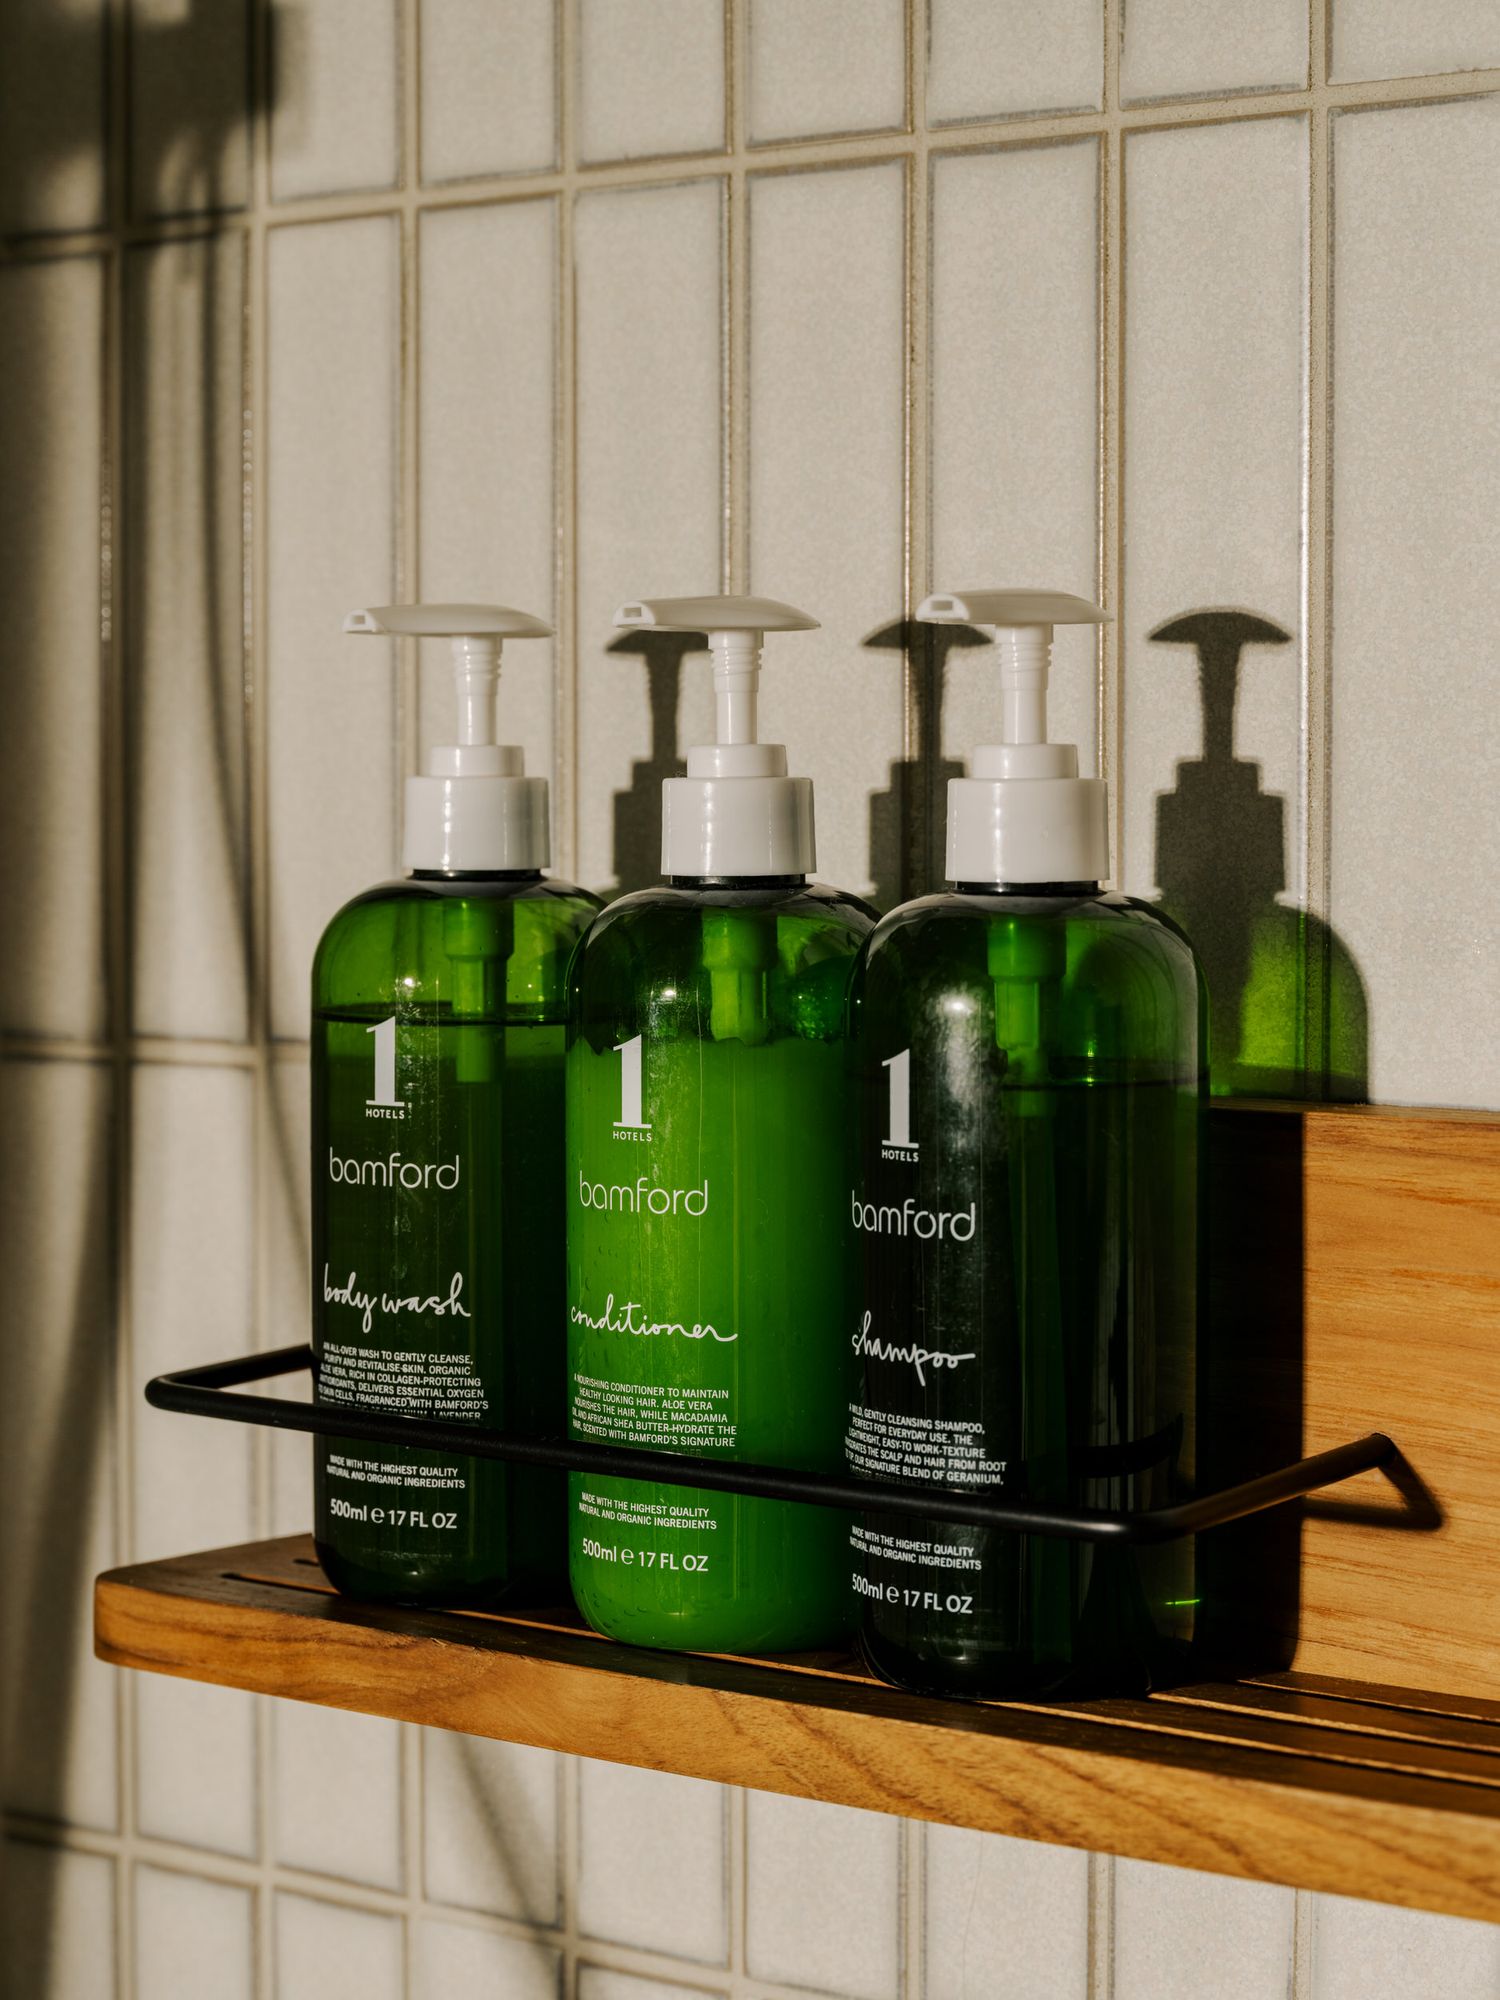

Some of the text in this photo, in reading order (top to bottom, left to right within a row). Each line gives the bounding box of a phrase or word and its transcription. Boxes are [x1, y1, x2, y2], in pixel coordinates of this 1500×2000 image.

[366, 1015, 405, 1107] 1
[613, 1034, 652, 1129] 1
[881, 1048, 919, 1149] 1
[365, 1108, 405, 1119] HOTELS
[612, 1131, 652, 1142] HOTELS
[329, 1146, 460, 1190] bamford
[881, 1149, 919, 1162] HOTELS
[579, 1170, 708, 1216] bamford
[852, 1190, 976, 1242] bamford
[323, 1262, 471, 1334] body wash
[571, 1293, 738, 1342] conditioner
[358, 1348, 379, 1359] WASH
[381, 1351, 392, 1360] TO
[394, 1352, 430, 1363] GENTLY
[428, 1354, 474, 1365] CLEANSE,
[851, 1310, 976, 1387] shampoo
[343, 1357, 356, 1366] AND
[429, 1366, 471, 1375] ORGANIC
[349, 1369, 365, 1380] RICH
[367, 1371, 375, 1381] IN
[377, 1373, 481, 1387] COLLAGEN-PROTECTING
[335, 1390, 355, 1401] CELLS,
[356, 1393, 407, 1407] FRAGRANCED
[409, 1397, 432, 1408] WITH
[435, 1400, 489, 1409] BAMFORD'S
[358, 1382, 394, 1395] DELIVERS
[397, 1386, 444, 1397] ESSENTIAL
[447, 1389, 484, 1398] OXYGEN
[577, 1375, 609, 1390] NOURISHING
[610, 1382, 664, 1396] CONDITIONER
[667, 1387, 680, 1397] TO
[682, 1389, 729, 1399] MAINTAIN
[579, 1387, 713, 1410] HEALTHY LOOKING HAIR. ALOE VERA
[588, 1412, 612, 1425] AFRICAN
[614, 1418, 633, 1429] SHEA
[636, 1422, 714, 1435] BUTTER-HYDRATE
[717, 1426, 737, 1435] THE
[602, 1404, 615, 1415] THE
[617, 1407, 638, 1419] HAIR,
[640, 1410, 668, 1420] WHILE
[671, 1412, 728, 1423] MACADAMIA
[864, 1409, 886, 1422] GENTLY
[887, 1414, 933, 1429] CLEANSING
[935, 1419, 985, 1434] SHAMPOO,
[583, 1423, 607, 1437] SCENTED
[608, 1428, 627, 1440] WITH
[628, 1432, 678, 1445] BAMFORD'S
[681, 1437, 735, 1447] SIGNATURE
[852, 1417, 973, 1445] PERFECT FOR EVERYDAY USE. THE
[868, 1446, 879, 1458] THE
[880, 1450, 903, 1462] SCALP
[904, 1455, 922, 1465] AND
[924, 1457, 945, 1467] HAIR
[949, 1458, 976, 1470] FROM
[979, 1461, 1007, 1472] ROOT
[882, 1437, 911, 1451] EASY-TO
[913, 1442, 986, 1458] WORK-TEXTURE
[346, 1458, 362, 1469] WITH
[364, 1461, 378, 1472] THE
[381, 1463, 418, 1475] HIGHEST
[420, 1466, 458, 1477] QUALITY
[351, 1471, 366, 1481] AND
[367, 1473, 402, 1486] ORGANIC
[404, 1477, 465, 1489] INGREDIENTS
[855, 1453, 864, 1464] OUR
[865, 1457, 900, 1475] SIGNATURE
[902, 1466, 930, 1479] BLEND
[933, 1470, 945, 1480] OF
[947, 1472, 1004, 1485] GERANIUM,
[330, 1498, 367, 1522] 500ml
[387, 1510, 406, 1526] 17
[410, 1511, 428, 1528] FL
[432, 1512, 457, 1529] OZ
[579, 1502, 717, 1530] NATURAL AND ORGANIC INGREDIENTS
[582, 1492, 709, 1518] MADE WITH THE HIGHEST QUALITY
[582, 1538, 617, 1562] 500ml
[638, 1551, 656, 1568] 17
[660, 1552, 679, 1570] FL
[682, 1554, 709, 1572] OZ
[864, 1530, 880, 1543] WITH
[880, 1535, 894, 1547] THE
[896, 1538, 932, 1553] HIGHEST
[934, 1544, 974, 1557] QUALITY
[869, 1544, 882, 1556] AND
[883, 1548, 916, 1563] ORGANIC
[919, 1554, 982, 1570] INGREDIENTS
[852, 1573, 883, 1600] 500ml
[903, 1589, 920, 1607] 17
[924, 1592, 943, 1611] FL
[946, 1594, 973, 1614] OZ
